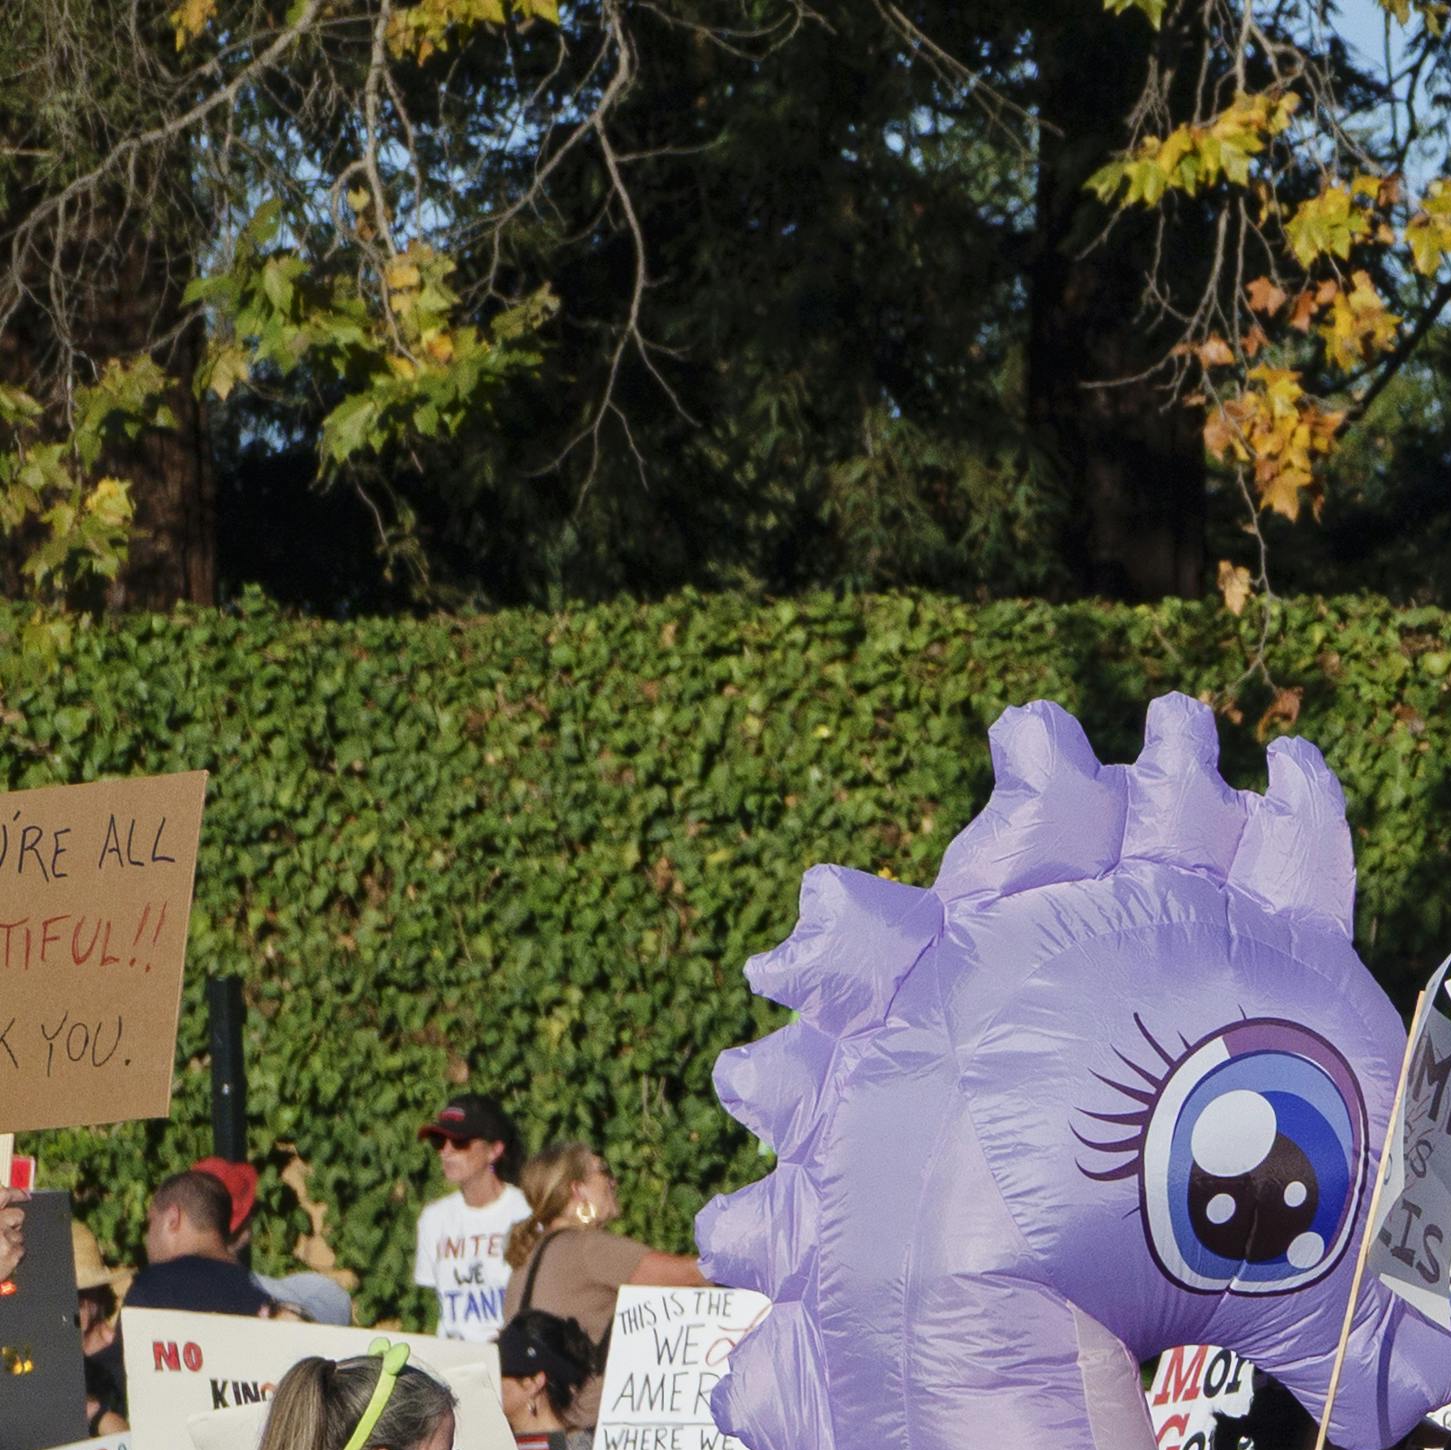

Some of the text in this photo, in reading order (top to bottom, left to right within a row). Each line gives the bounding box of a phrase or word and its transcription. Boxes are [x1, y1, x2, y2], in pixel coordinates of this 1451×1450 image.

[99, 813, 175, 868] ALL
[41, 1010, 131, 1077] YOU.
[438, 1232, 505, 1259] NITE
[454, 1263, 484, 1286] WE
[440, 1288, 507, 1324] TAN
[618, 1291, 735, 1336] THIS IS THE
[152, 1341, 204, 1373] NO
[652, 1323, 706, 1366] WE
